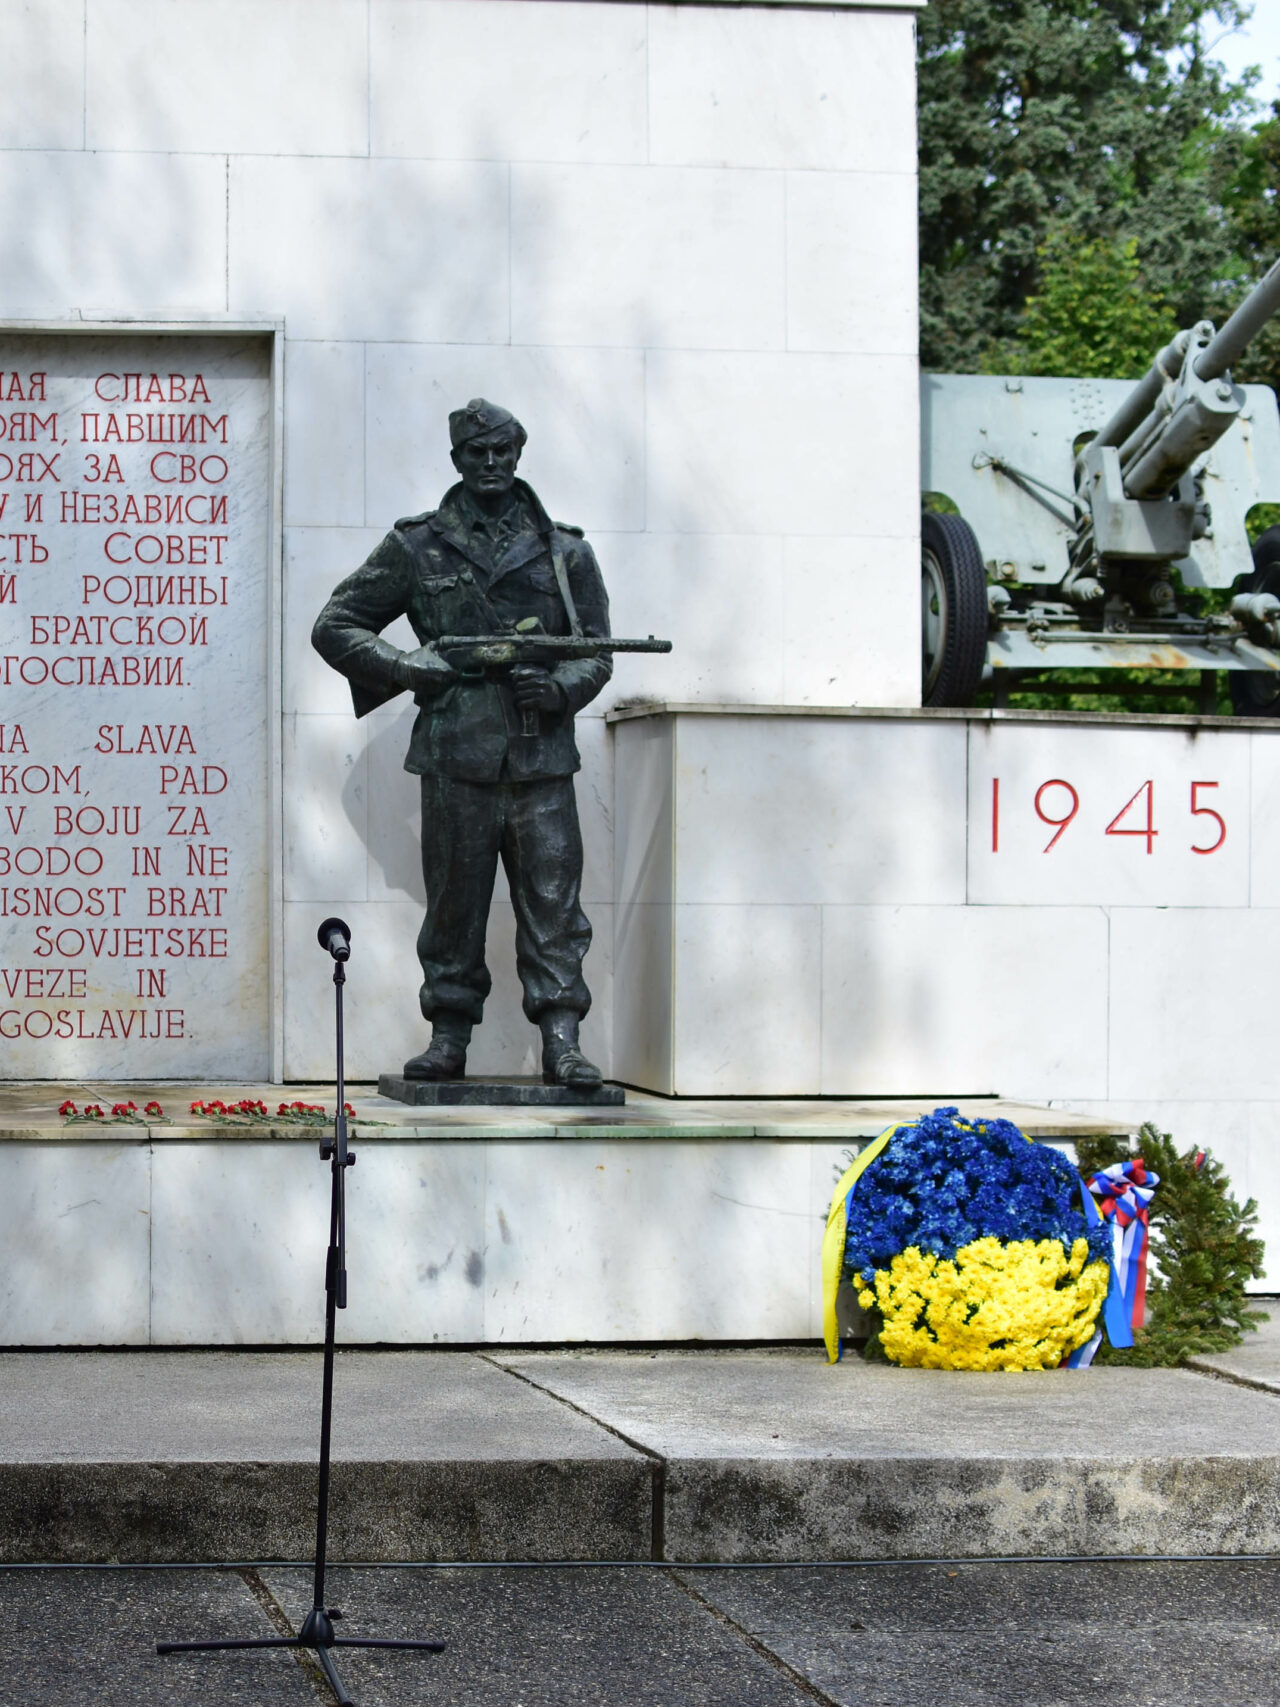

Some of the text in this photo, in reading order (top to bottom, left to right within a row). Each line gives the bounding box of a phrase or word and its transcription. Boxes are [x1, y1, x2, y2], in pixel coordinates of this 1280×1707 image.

[95, 374, 210, 403] СЛАВА
[82, 413, 227, 444] ПАВШИМ
[84, 454, 124, 483] ЗА
[150, 451, 228, 484] СВО
[26, 494, 42, 523] И
[61, 491, 227, 525] НЕЗАВИСИ
[104, 532, 228, 565] СОВЕТ
[84, 576, 227, 608] РОДИНЫ
[30, 612, 208, 645] БРАТСКОЙ
[96, 725, 195, 754] SLAVA
[161, 766, 228, 795] PAD
[7, 806, 25, 835] V
[56, 806, 140, 836] BOJU
[168, 806, 209, 836] ZA
[992, 778, 1227, 855] 1945
[133, 847, 160, 876] IN
[188, 844, 228, 876] NE
[148, 888, 227, 917] BRAT
[35, 926, 227, 958] SOVJETSKE
[138, 969, 165, 999] IN
